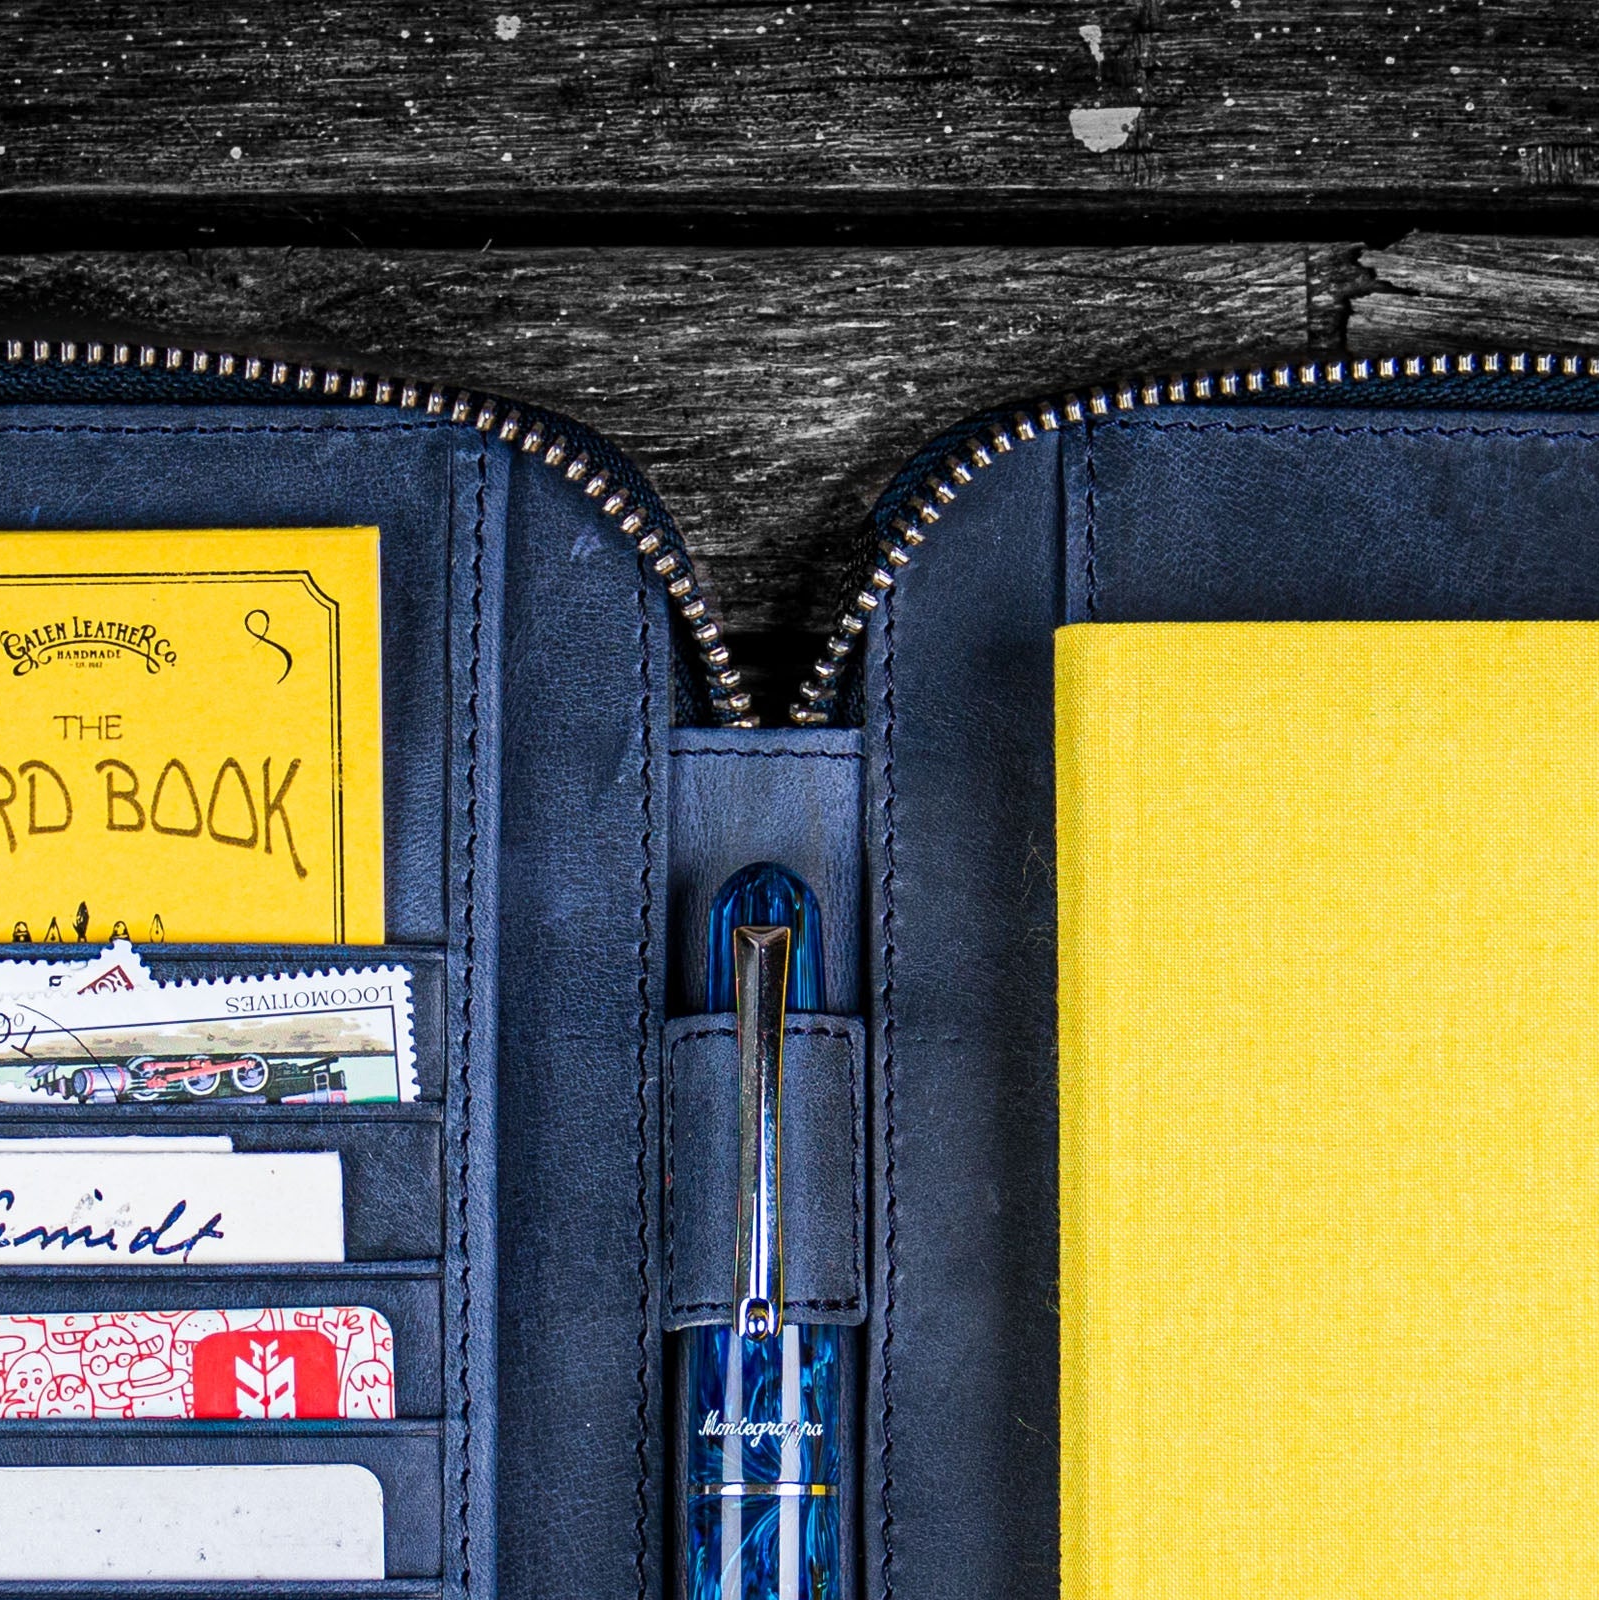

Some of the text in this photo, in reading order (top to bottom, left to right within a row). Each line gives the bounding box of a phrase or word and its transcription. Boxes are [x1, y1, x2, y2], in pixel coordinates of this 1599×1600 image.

[57, 649, 121, 660] HANDMADE
[53, 715, 123, 740] THE
[96, 756, 308, 880] BOOK
[226, 984, 394, 1014] LOCOMOTIVES
[698, 1409, 824, 1449] Montegrappa
